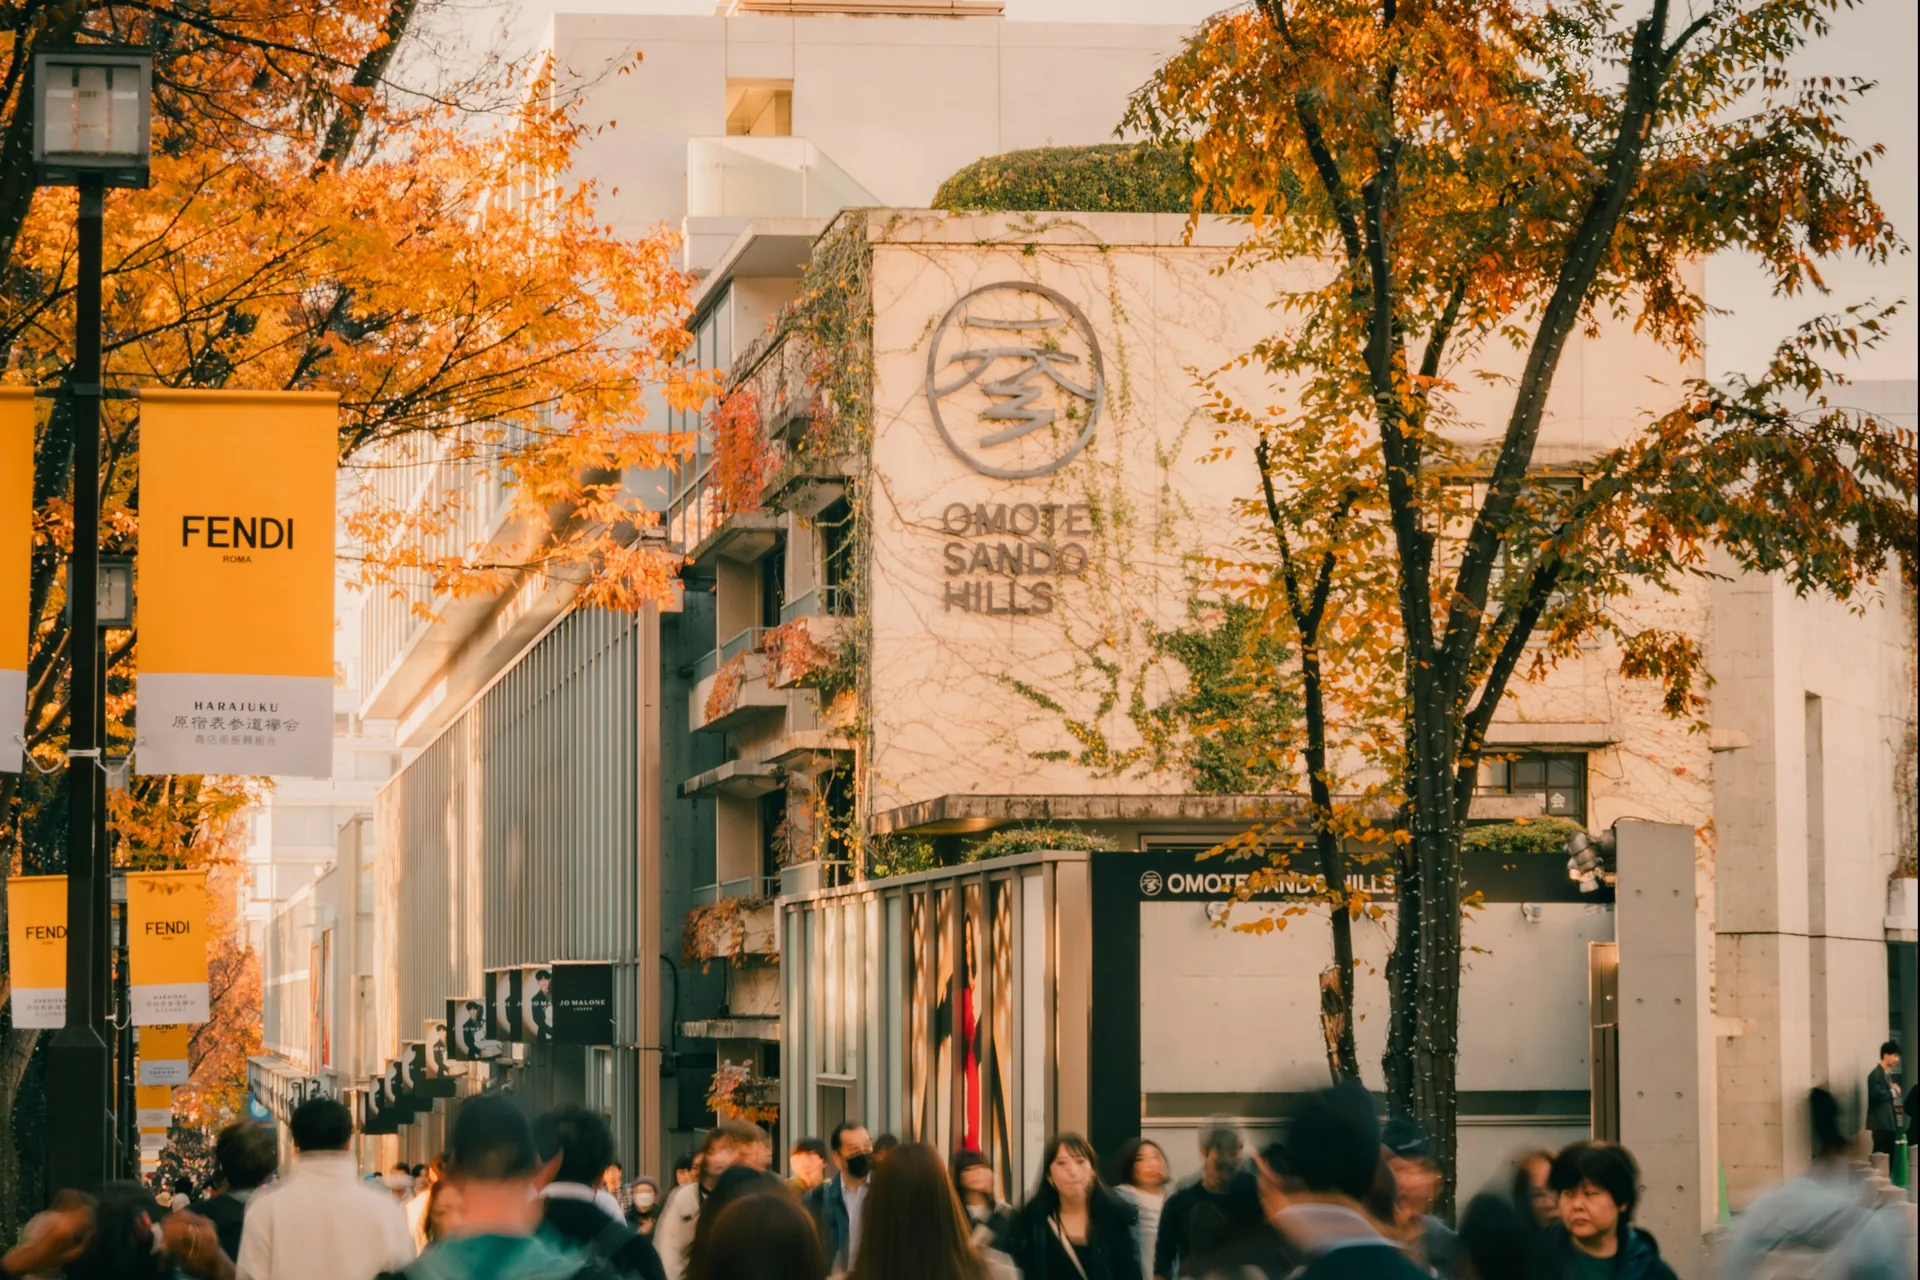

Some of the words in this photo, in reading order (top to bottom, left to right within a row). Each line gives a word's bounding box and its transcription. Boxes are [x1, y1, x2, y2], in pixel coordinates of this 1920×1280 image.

[942, 502, 1092, 537] OMOTE
[182, 515, 294, 550] FENDI
[222, 555, 253, 564] ROMA
[942, 541, 1089, 576] SANDO
[943, 581, 1055, 615] HILLS
[194, 701, 280, 713] HARAJUKU
[25, 925, 67, 940] FEND
[145, 920, 190, 936] FENDI
